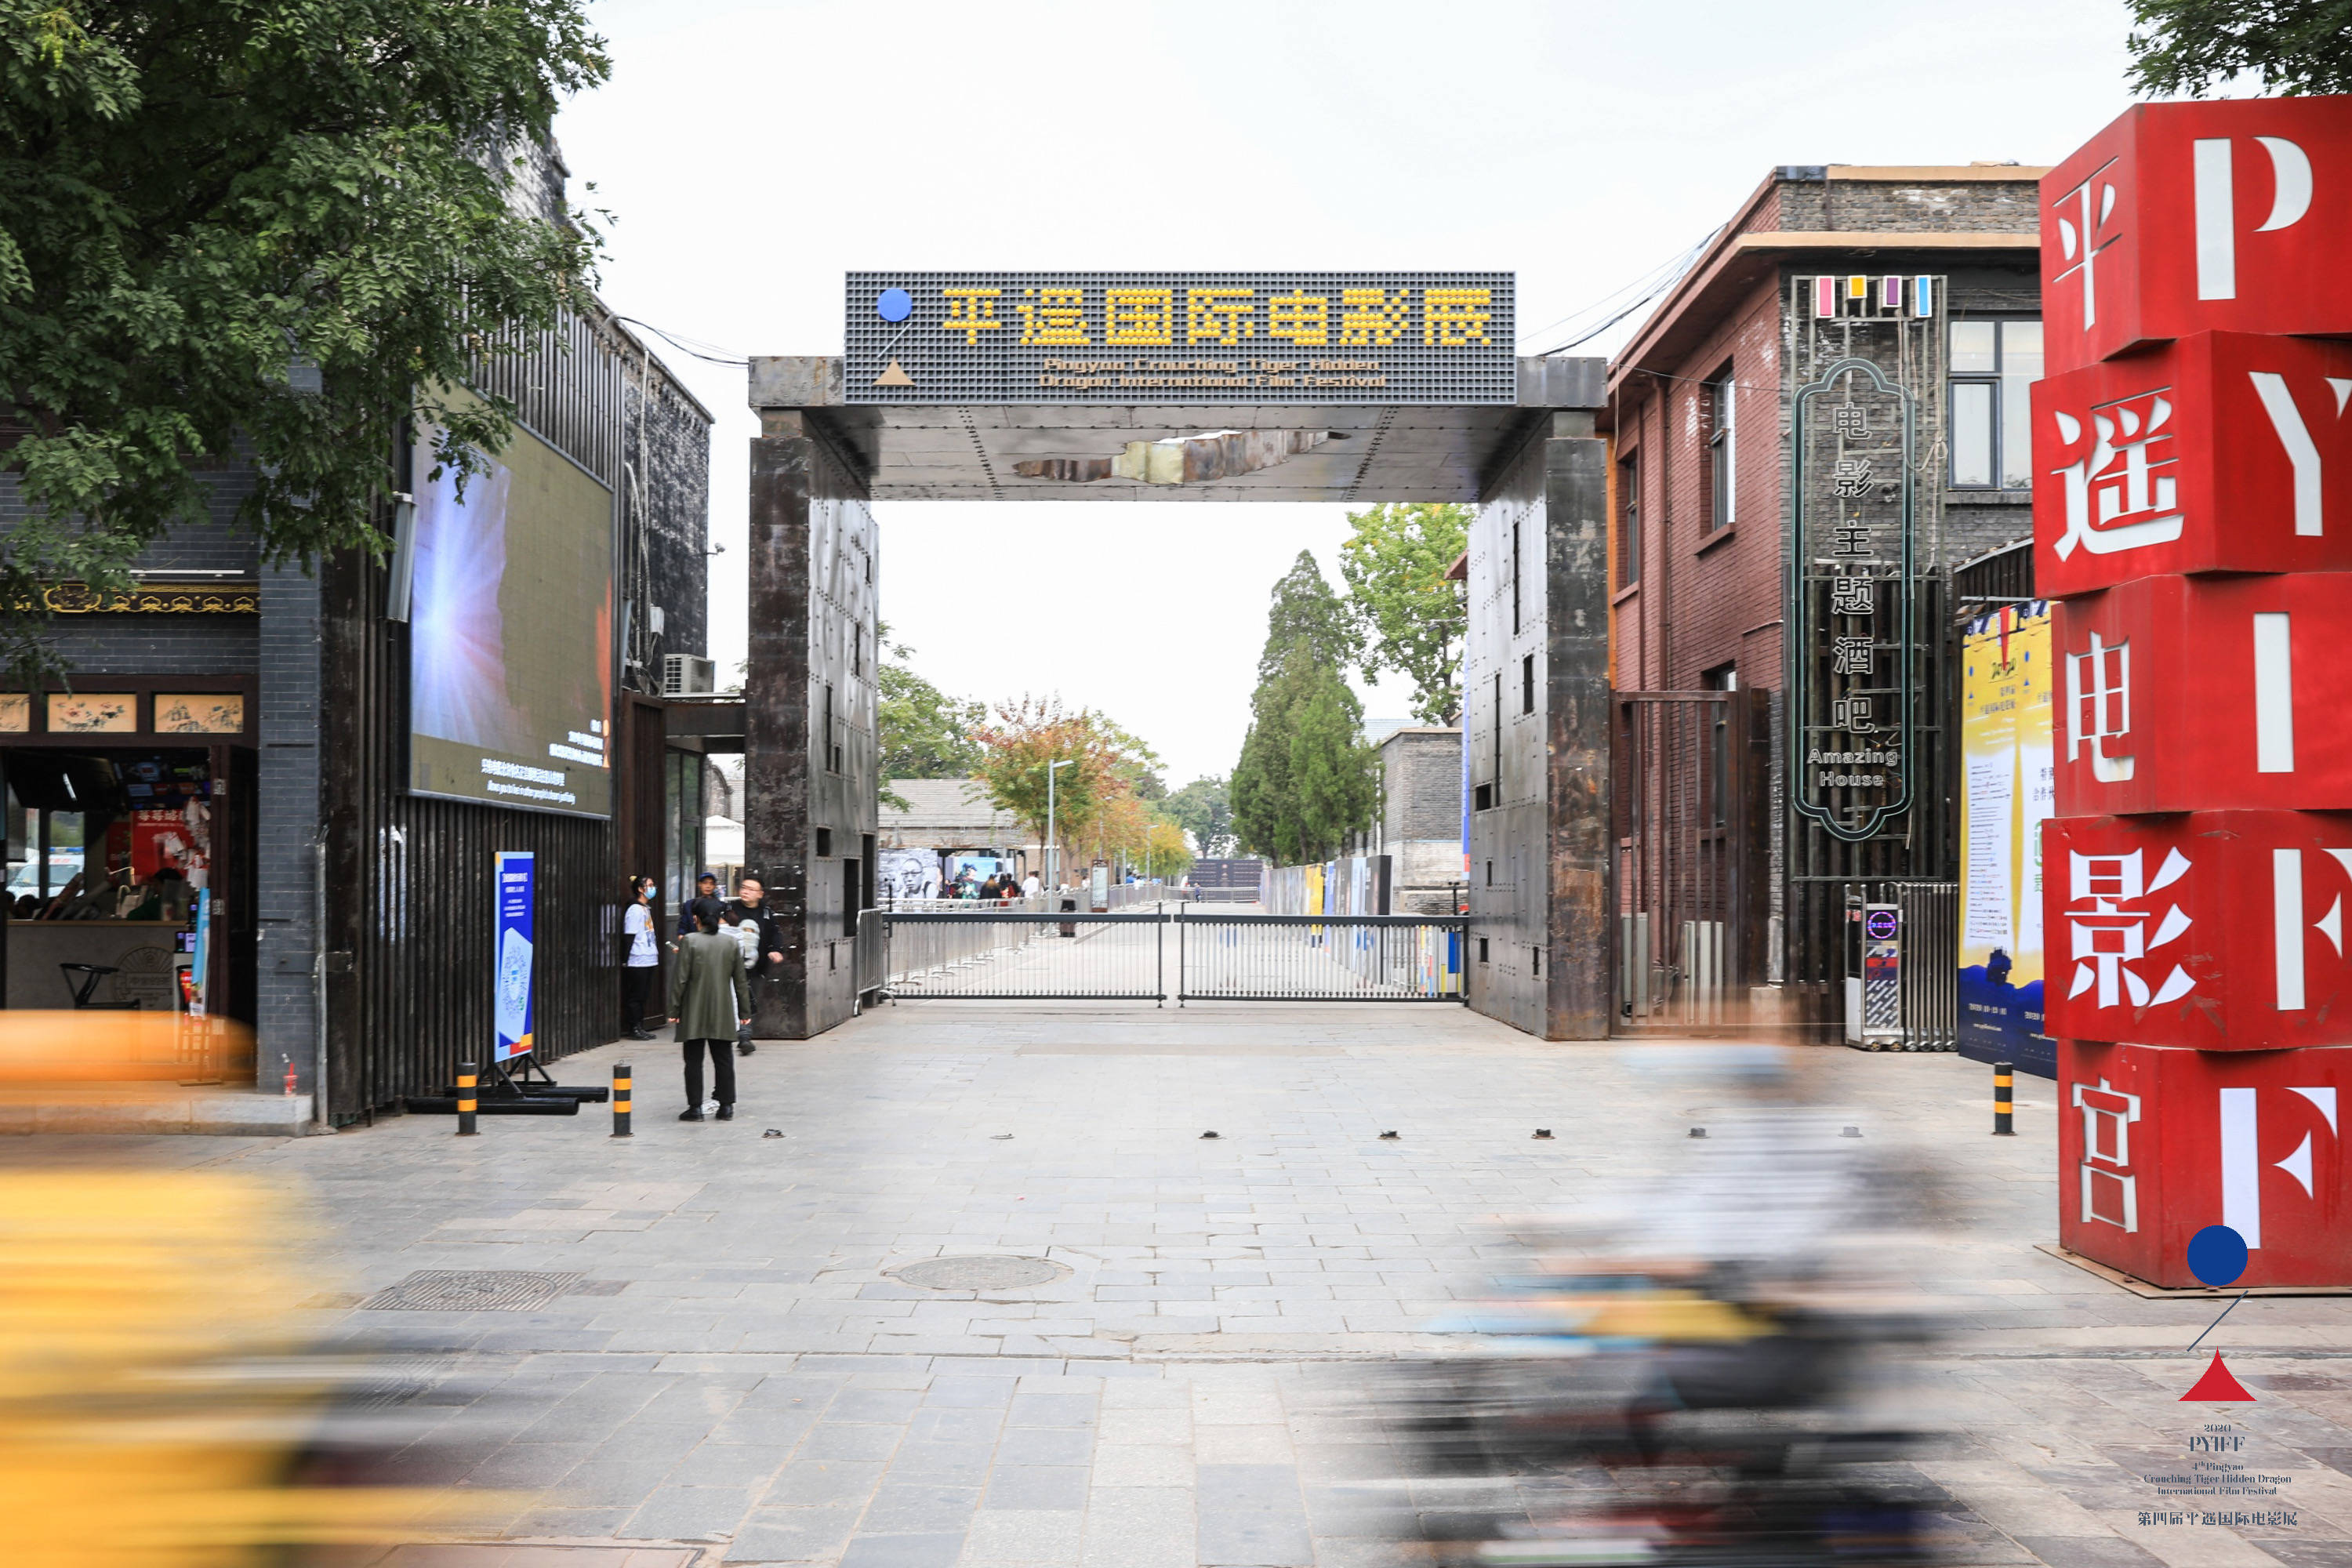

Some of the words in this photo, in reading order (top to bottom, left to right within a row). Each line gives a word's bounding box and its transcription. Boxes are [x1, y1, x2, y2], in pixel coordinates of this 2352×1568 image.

[943, 289, 1491, 346] 平遥国际电影展
[1044, 358, 1125, 373] Pingyao
[1134, 358, 1237, 373] Crouching
[1247, 358, 1301, 375] Tiger
[1309, 358, 1380, 370] Hidden
[1040, 375, 1112, 389] Dragon
[1119, 375, 1248, 387] International
[1255, 375, 1294, 387] Film
[1304, 375, 1386, 387] Festival
[1831, 401, 1876, 734] 电影主题酒吧
[1806, 748, 1897, 767] Amazing
[1819, 771, 1884, 787] House
